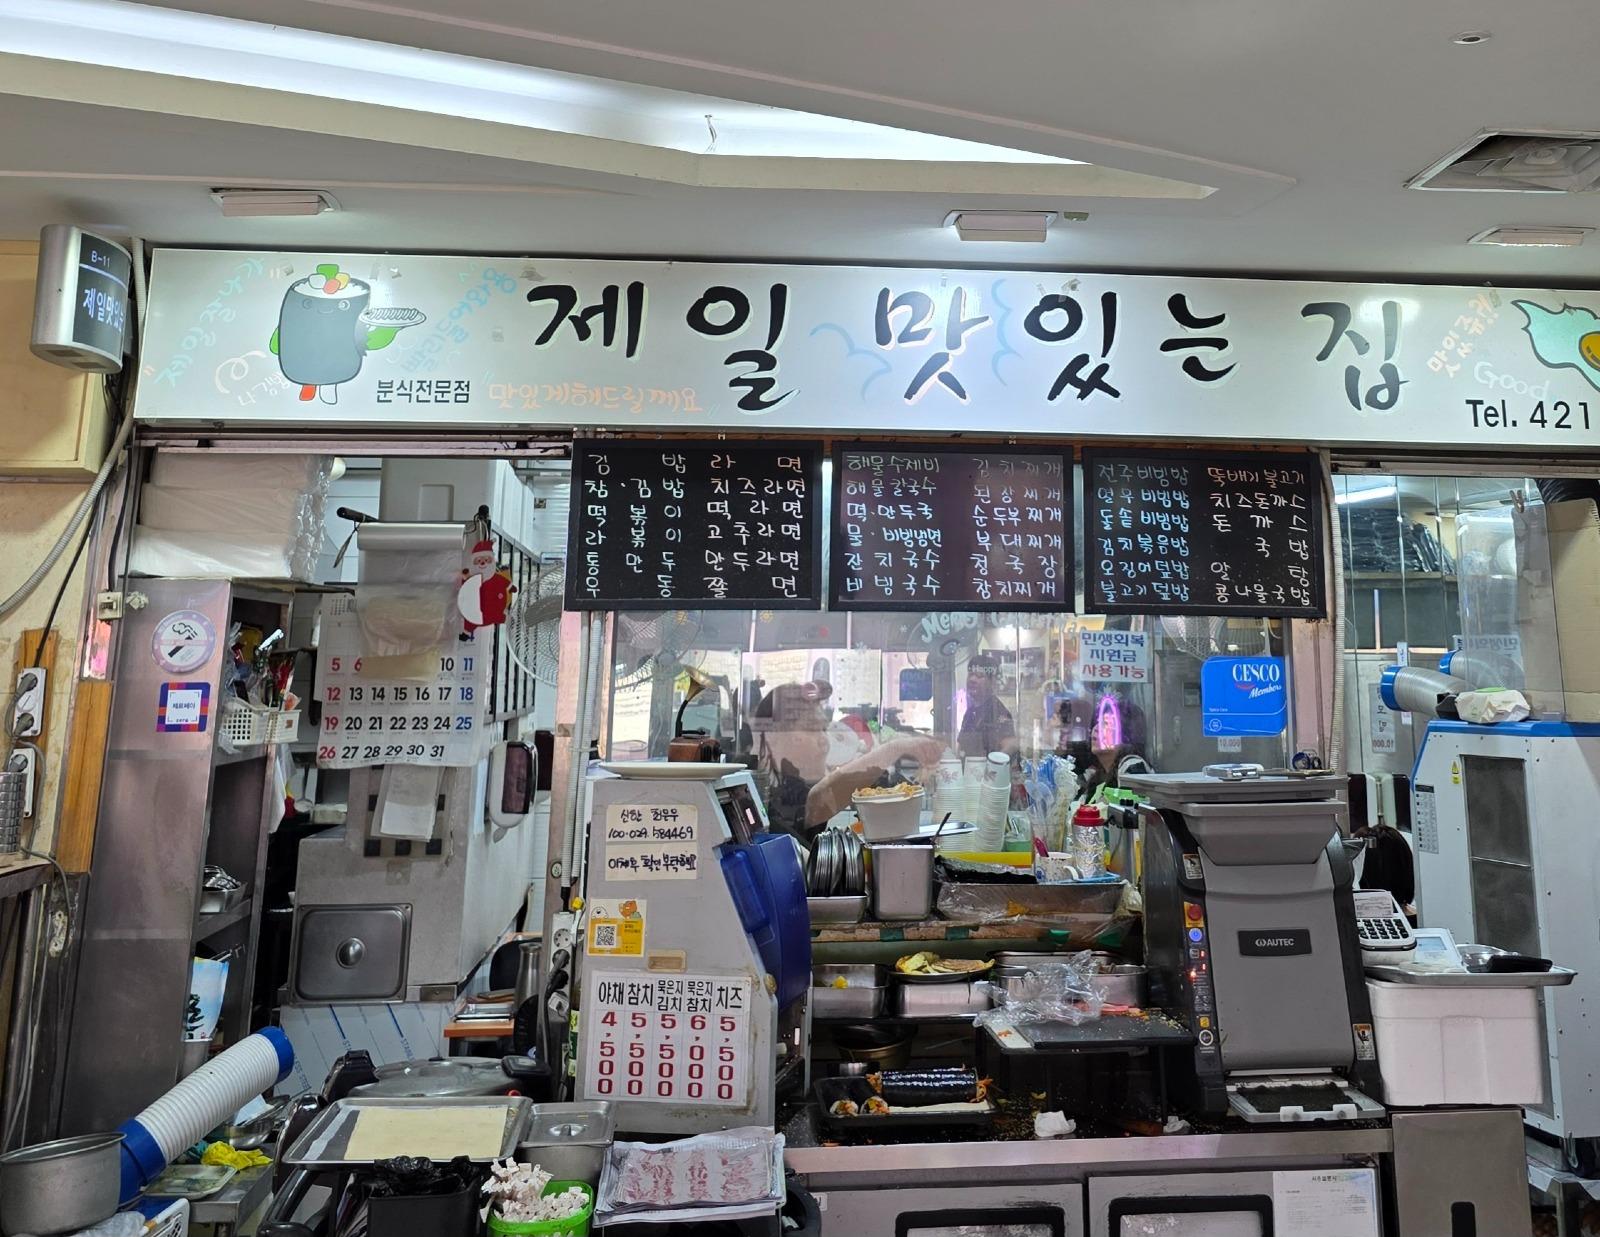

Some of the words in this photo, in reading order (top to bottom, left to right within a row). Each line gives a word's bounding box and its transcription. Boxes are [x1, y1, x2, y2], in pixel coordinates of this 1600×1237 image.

[91, 250, 110, 268] B-11
[376, 379, 470, 403] 분식전문점
[1465, 399, 1517, 427] Tel.
[1529, 401, 1590, 429] 421
[1082, 633, 1145, 647] 민생회복
[1090, 648, 1137, 663] 지원금
[331, 658, 341, 671] 5
[440, 657, 454, 671] 10
[463, 658, 473, 671] 11
[1232, 664, 1280, 682] CESCO
[327, 687, 341, 701] 12
[349, 687, 363, 700] 13
[371, 687, 385, 700] 14
[394, 687, 407, 700] 15
[415, 687, 430, 700] 16
[438, 687, 452, 700] 17
[460, 687, 473, 700] 18
[325, 717, 339, 730] 19
[345, 717, 362, 730] 20
[369, 717, 383, 730] 21
[390, 717, 406, 730] 22
[412, 717, 428, 730] 23
[434, 717, 451, 730] 24
[456, 717, 472, 730] 25
[319, 746, 336, 760] 26
[342, 746, 359, 759] 27
[363, 746, 380, 758] 28
[385, 745, 403, 756] 29
[406, 745, 425, 756] 30
[430, 745, 444, 758] 31
[621, 809, 642, 823] 신한
[1266, 938, 1295, 946] AUTEC
[599, 981, 625, 1005] 야채
[627, 982, 654, 1006] 참치
[657, 980, 684, 995] 묵은지
[687, 981, 713, 996] 묵은지
[715, 986, 743, 1009] 치즈
[657, 996, 682, 1012] 김치
[686, 997, 712, 1013] 참치
